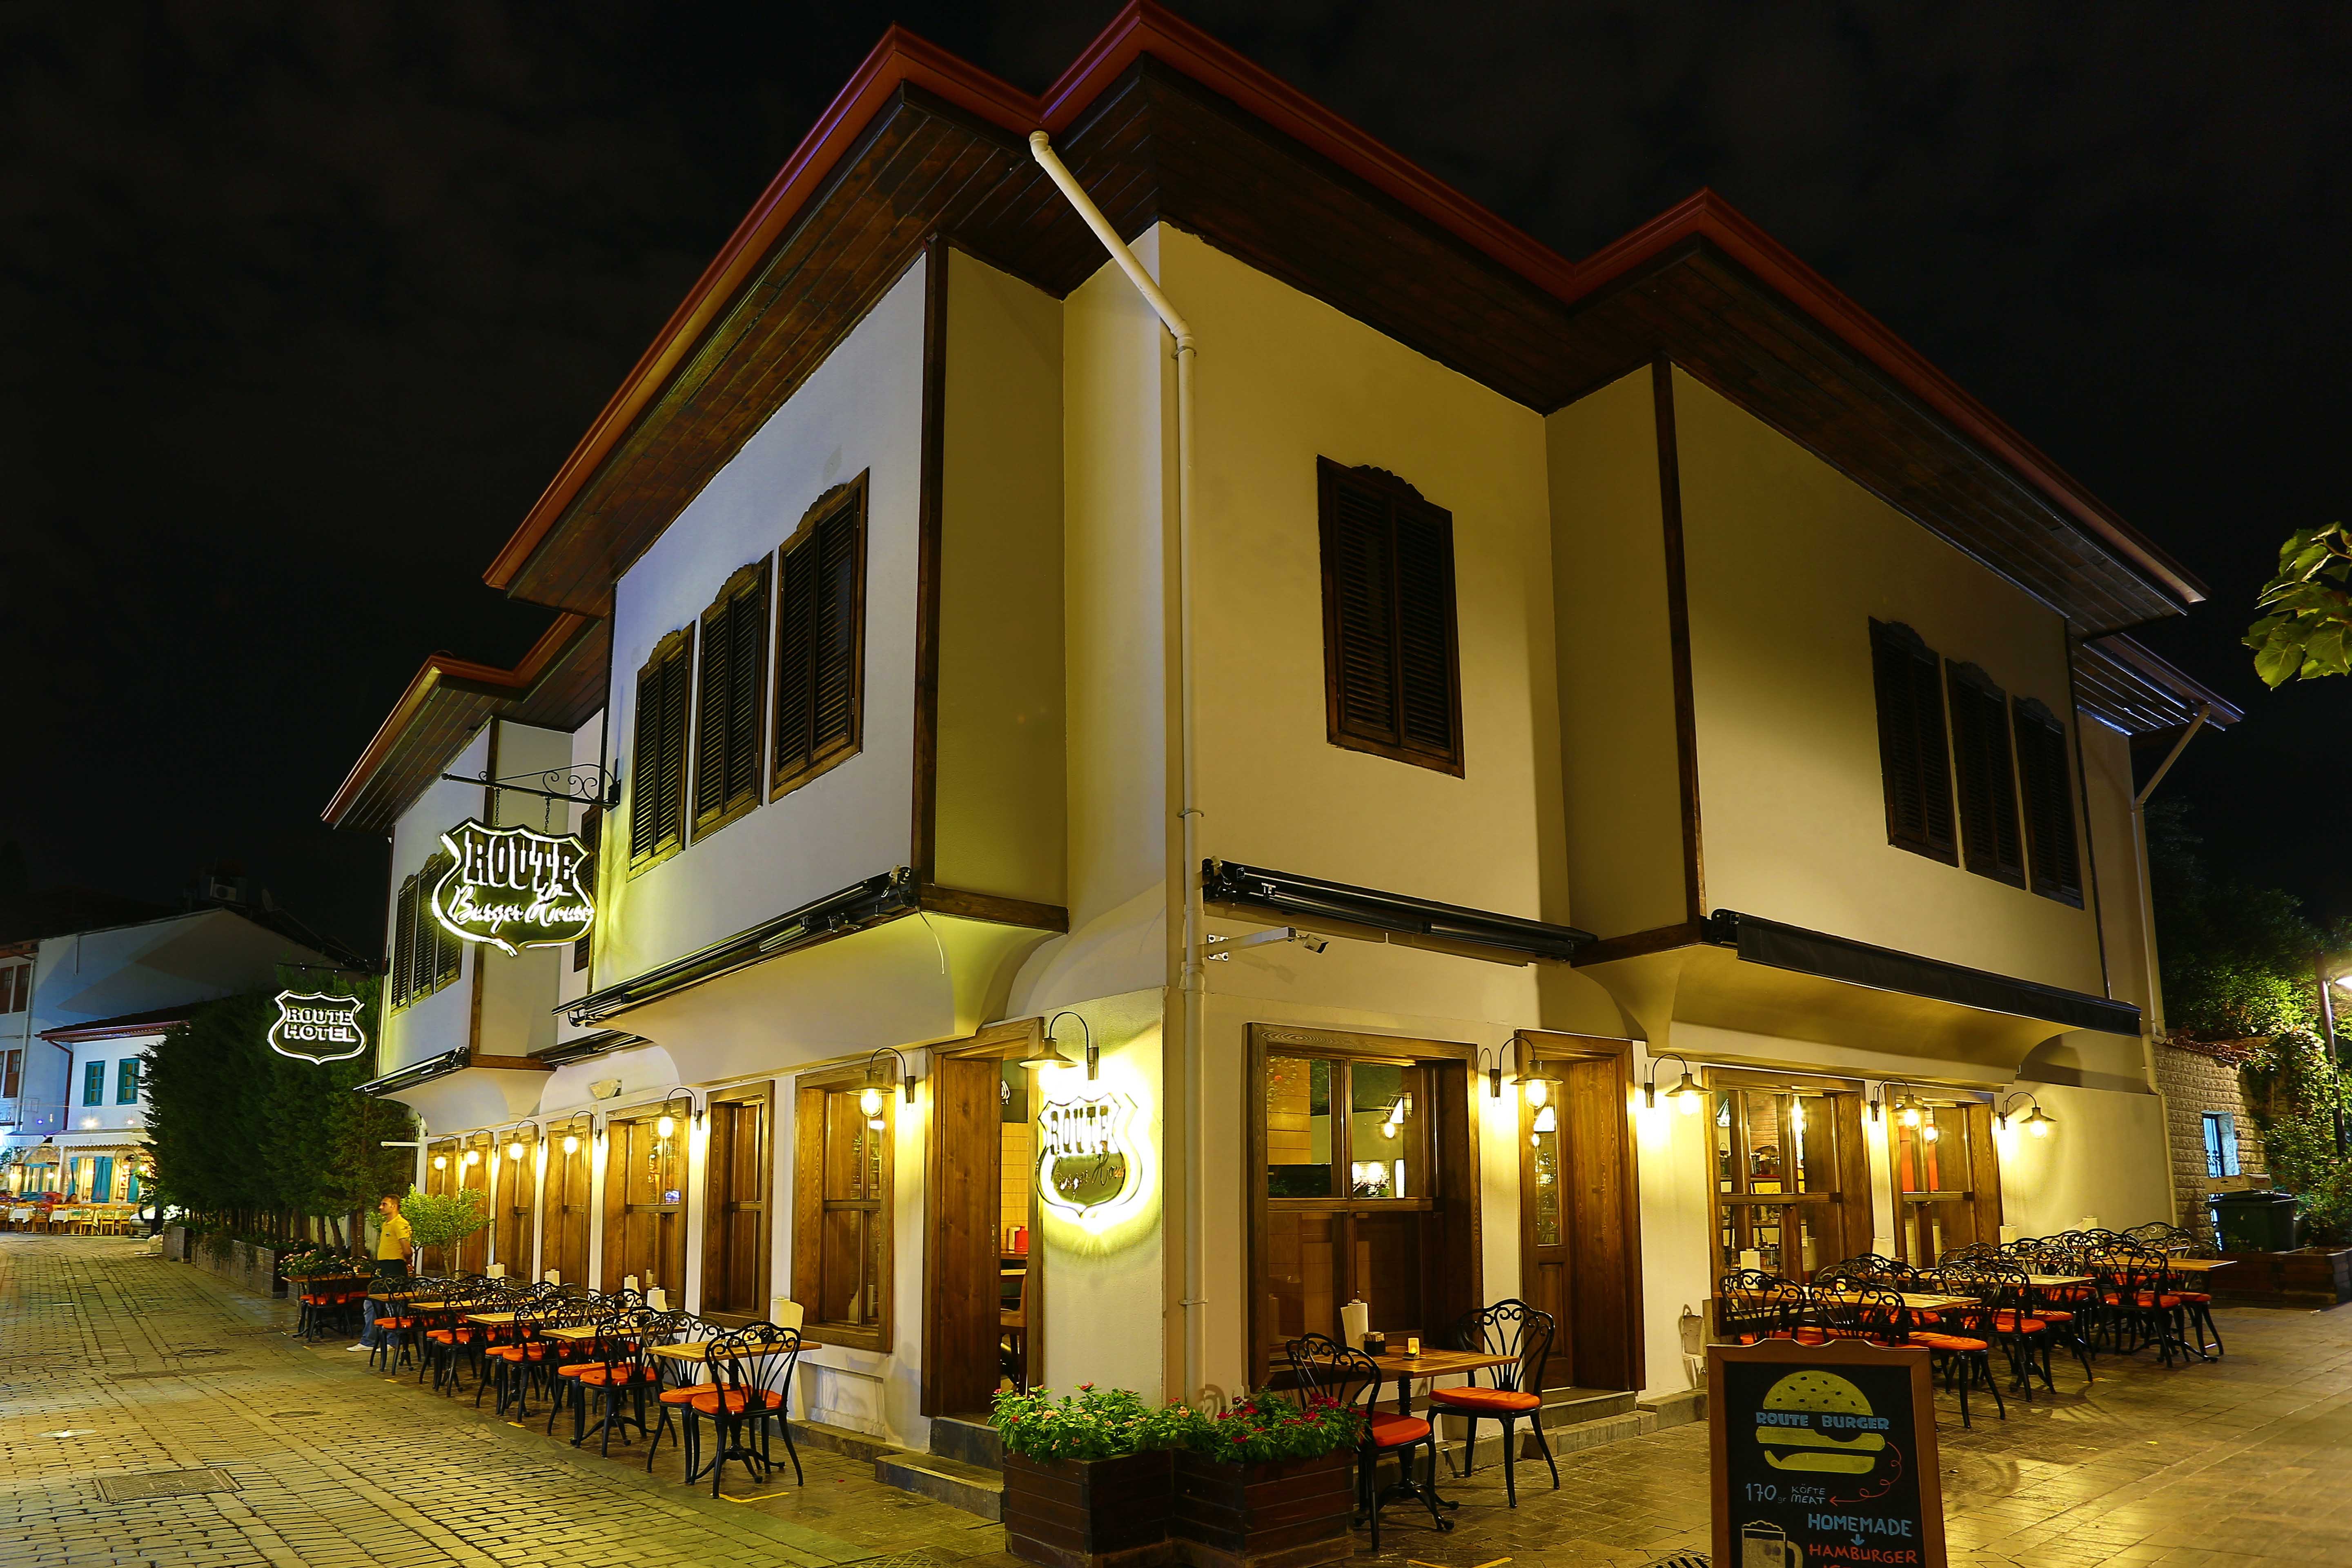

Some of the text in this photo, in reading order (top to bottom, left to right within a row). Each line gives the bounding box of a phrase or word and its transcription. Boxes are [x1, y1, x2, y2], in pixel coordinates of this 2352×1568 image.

[464, 831, 572, 896] ROUTE
[447, 884, 524, 934] Burger
[286, 1007, 352, 1026] ROUTE
[284, 1023, 356, 1042] HOTEL
[1050, 1105, 1109, 1155] ROUTE
[1756, 1412, 1889, 1430] ROUTE BURGER
[1746, 1483, 1776, 1502] 170
[1791, 1483, 1826, 1494] KÖFTE
[1791, 1494, 1826, 1505] MEAT
[1808, 1513, 1913, 1537] HOMEMADE
[1809, 1544, 1918, 1564] HAMBURGER
